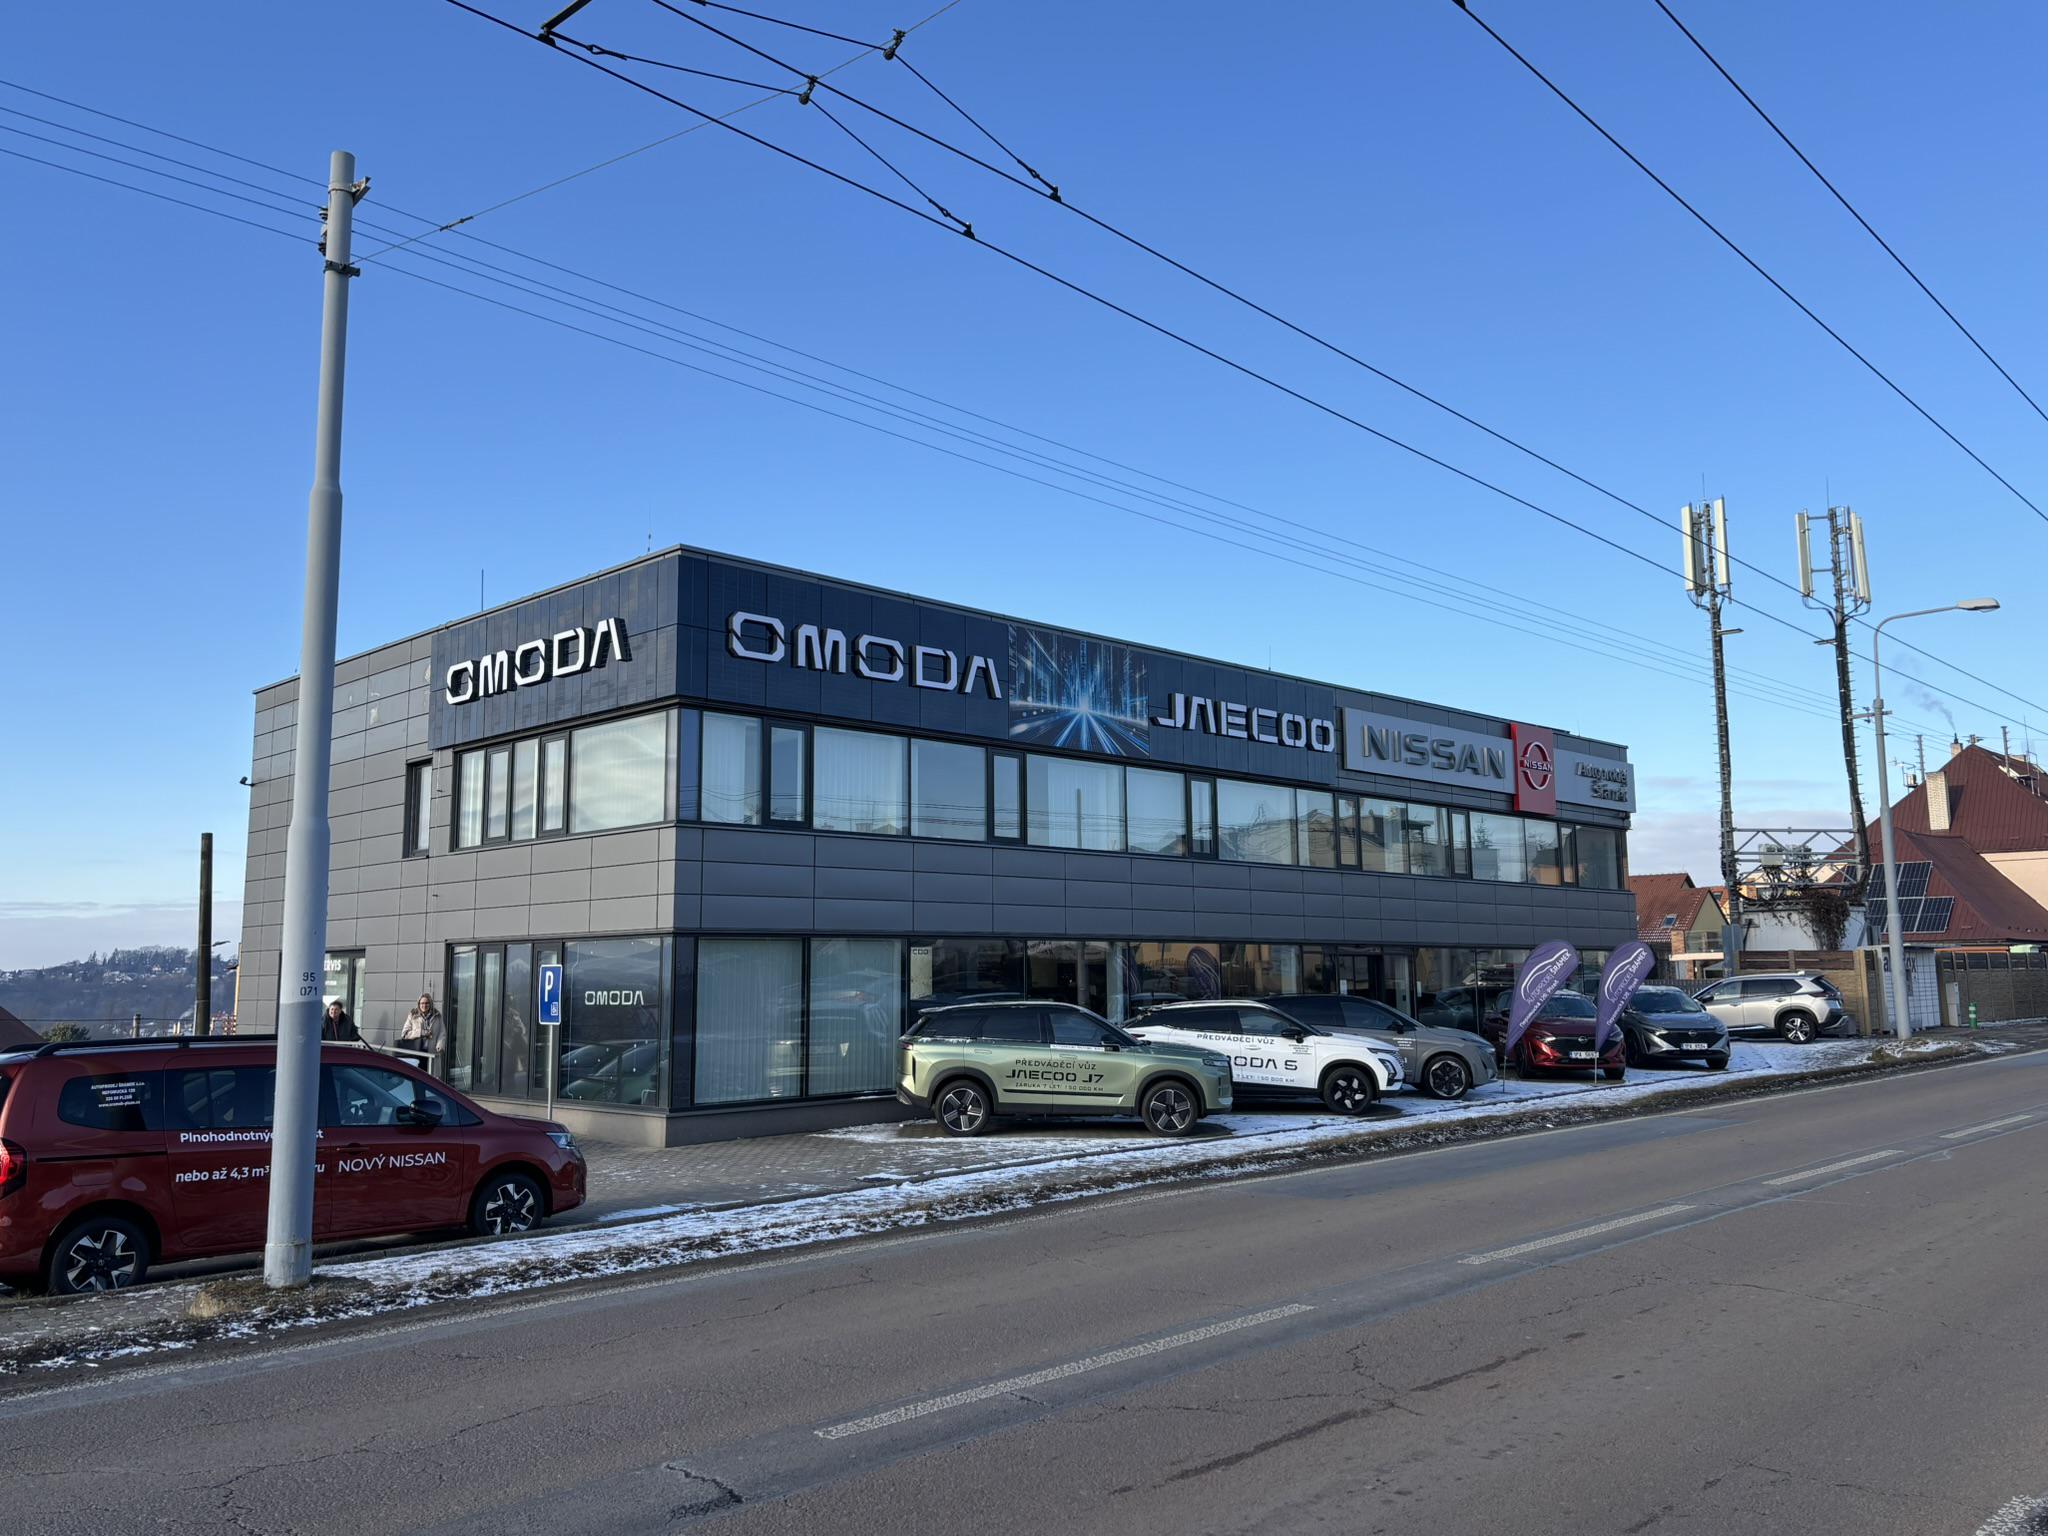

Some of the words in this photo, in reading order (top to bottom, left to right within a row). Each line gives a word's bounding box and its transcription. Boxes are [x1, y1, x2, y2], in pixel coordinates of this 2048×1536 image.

[446, 617, 630, 705] OMODA
[728, 610, 1002, 698] OMODA
[1153, 692, 1335, 752] JAECOO
[1362, 724, 1505, 778] NISSAN
[1524, 760, 1553, 772] NISSAN
[323, 959, 342, 971] ERVIS
[302, 971, 317, 982] 95
[300, 986, 318, 996] 071
[544, 970, 554, 1003] P
[584, 990, 645, 1006] OMODA
[1196, 1032, 1255, 1043] PŘEDVÁDĚCÍ
[1257, 1036, 1275, 1045] VŮZ
[1015, 1058, 1075, 1070] PŘEDVÁDĚCÍ
[1078, 1061, 1097, 1070] VŮZ
[1226, 1055, 1278, 1070] ODA
[1005, 1069, 1077, 1082] JAECOO
[1082, 1073, 1105, 1084] J7
[180, 1130, 274, 1143] Plnohodnotný
[338, 1153, 386, 1173] NOVÝ
[389, 1151, 446, 1168] NISSAN
[175, 1168, 210, 1183] nebo
[212, 1167, 228, 1180] až
[230, 1166, 250, 1180] 4,3
